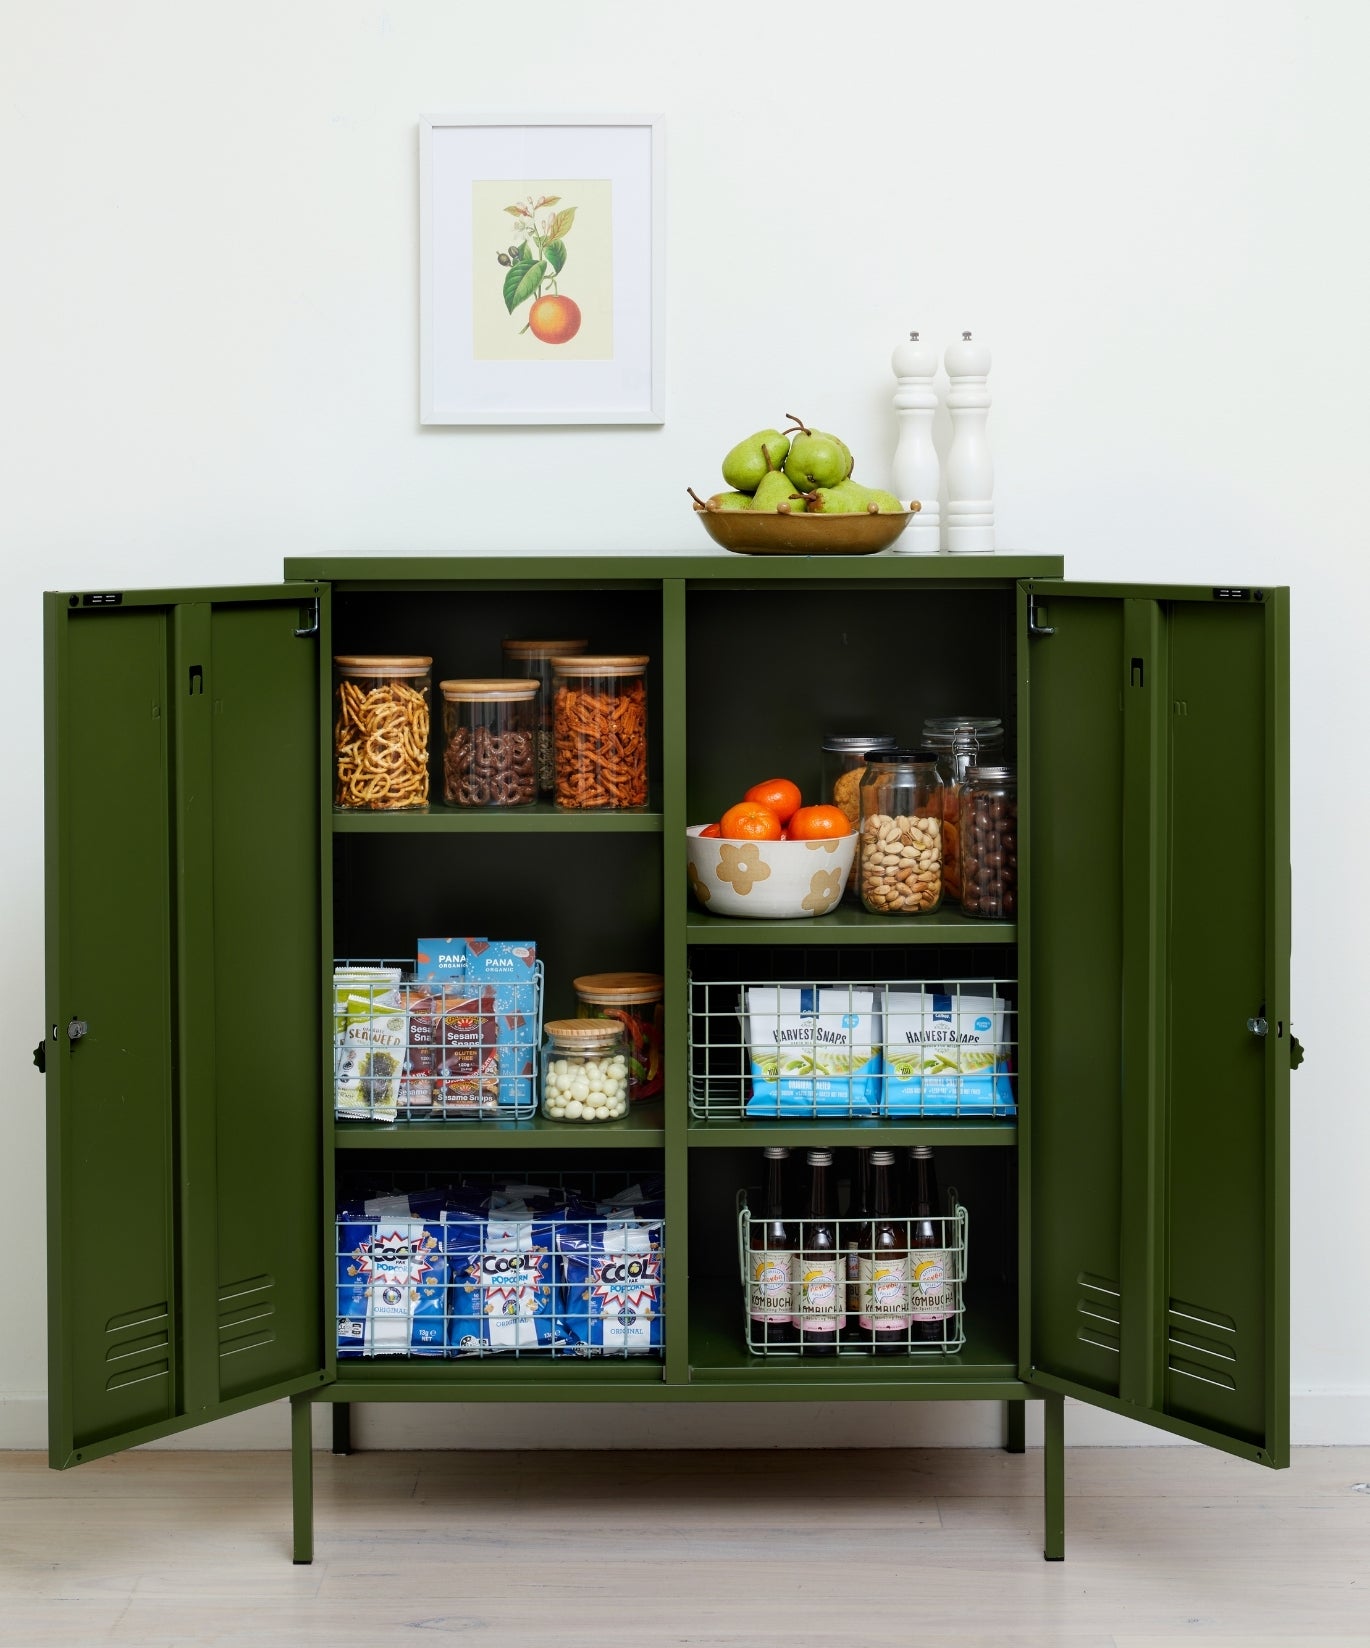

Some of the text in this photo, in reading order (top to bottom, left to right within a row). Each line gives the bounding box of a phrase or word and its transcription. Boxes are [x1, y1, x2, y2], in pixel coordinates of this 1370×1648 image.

[438, 955, 466, 963] PANA
[485, 959, 514, 967] PANA
[447, 1032, 484, 1041] Sesame
[772, 1027, 847, 1045] HARVEST SNAPS
[368, 1243, 423, 1265] COOL
[483, 1254, 538, 1275] COOL
[601, 1259, 655, 1283] COOL
[491, 1274, 529, 1285] POPCORN
[609, 1284, 645, 1294] POPCORN
[373, 1306, 409, 1314] ORIGINAL
[419, 1329, 429, 1337] 13g
